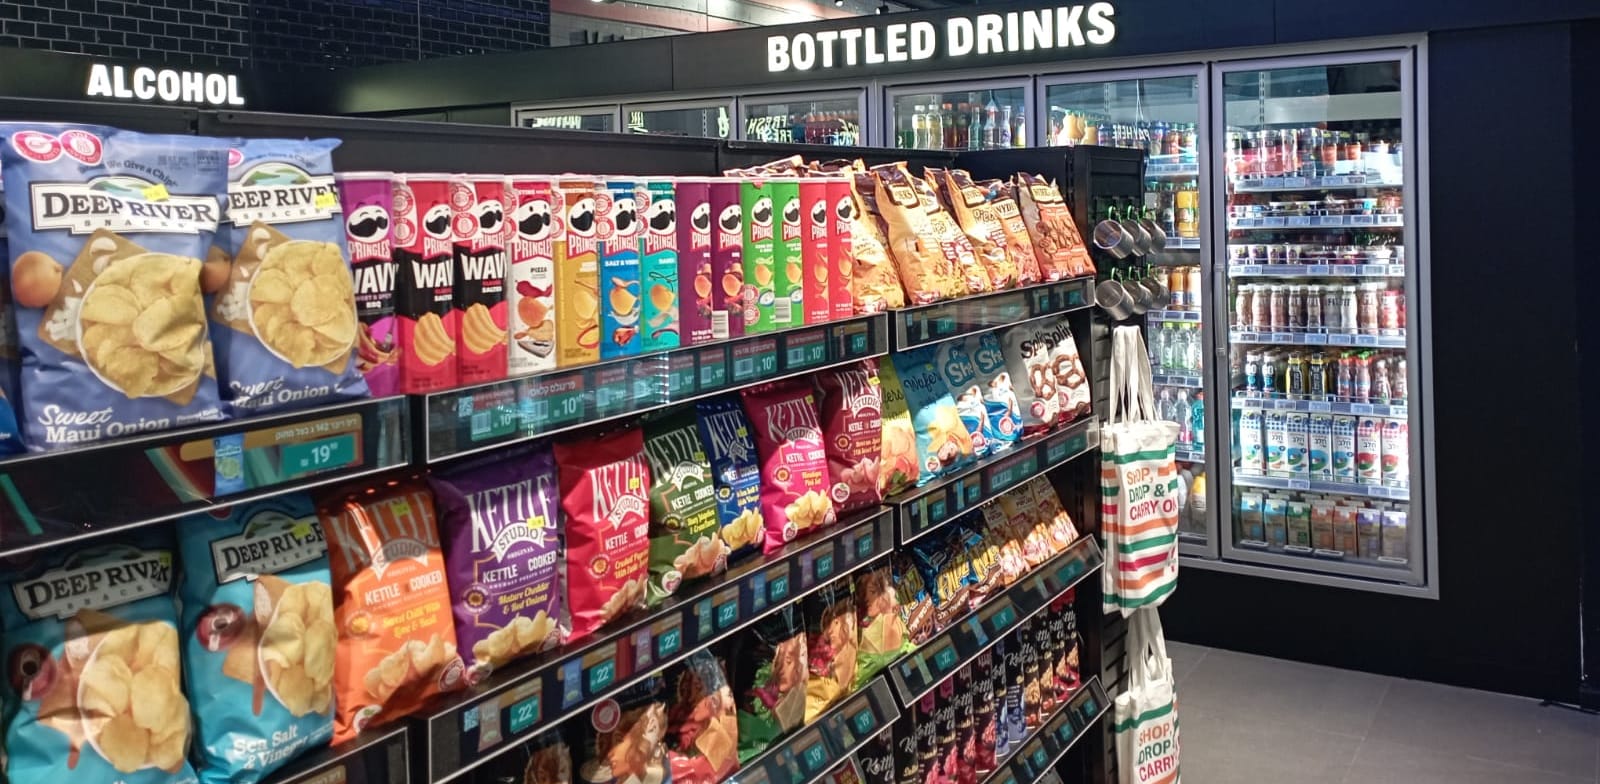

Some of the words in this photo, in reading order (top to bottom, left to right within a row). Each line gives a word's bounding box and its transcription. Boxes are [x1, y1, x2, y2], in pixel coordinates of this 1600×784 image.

[767, 20, 937, 73] BOTTLED
[946, 1, 1116, 57] DRINKS
[87, 63, 245, 105] ALCOHOL
[124, 160, 145, 171] Give
[41, 192, 124, 218] DEEP
[126, 201, 216, 223] RIVER
[228, 189, 271, 210] EEP
[348, 240, 391, 260] PRINGLES
[761, 356, 772, 371] 10
[278, 385, 329, 401] Onion
[38, 403, 114, 427] Sweet
[562, 398, 577, 415] 10
[46, 424, 100, 443] Maui
[107, 417, 170, 437] Onion
[312, 445, 330, 464] 19
[1126, 467, 1154, 486] SHOP,
[588, 451, 650, 524] KETTLE
[1129, 484, 1150, 504] DROP
[1154, 483, 1165, 498] &
[464, 472, 558, 553] KETTLE
[614, 497, 640, 520] STUDIO
[1130, 500, 1159, 521] CARRY
[498, 523, 539, 551] STUDIO
[605, 532, 628, 550] KETTLE
[222, 540, 270, 571] DEEP
[507, 547, 534, 560] ORIGINAL
[482, 564, 519, 583] KETTLE
[528, 550, 557, 572] COOKED
[24, 571, 102, 609] DEEP
[104, 559, 170, 586] RIVER
[365, 583, 401, 606] KETTLE
[524, 582, 551, 597] Cheddar
[724, 604, 735, 617] 22
[664, 634, 677, 649] 22
[597, 667, 611, 685] 22
[518, 700, 534, 719] 22
[233, 738, 268, 755] Sea
[271, 725, 298, 747] Salt
[1138, 722, 1173, 747] SHOP,
[811, 748, 822, 762] 19
[1138, 739, 1171, 765] DROP
